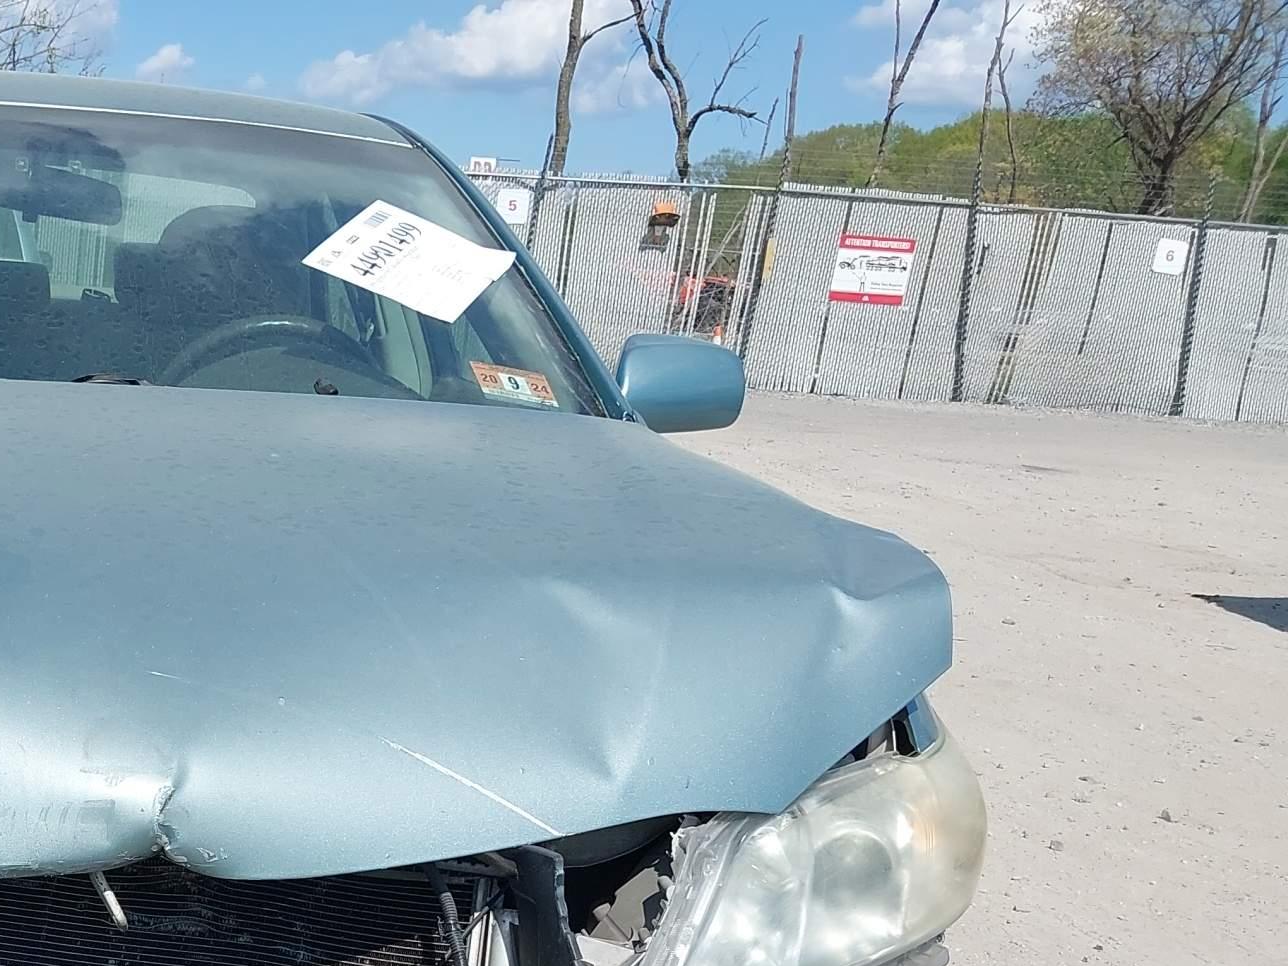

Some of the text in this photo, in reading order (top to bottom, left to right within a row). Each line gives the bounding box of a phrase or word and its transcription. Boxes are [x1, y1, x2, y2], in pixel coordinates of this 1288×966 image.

[508, 199, 517, 211] 5
[350, 222, 422, 277] 44901499
[1165, 249, 1175, 262] 6
[480, 373, 550, 394] 20 9 24
